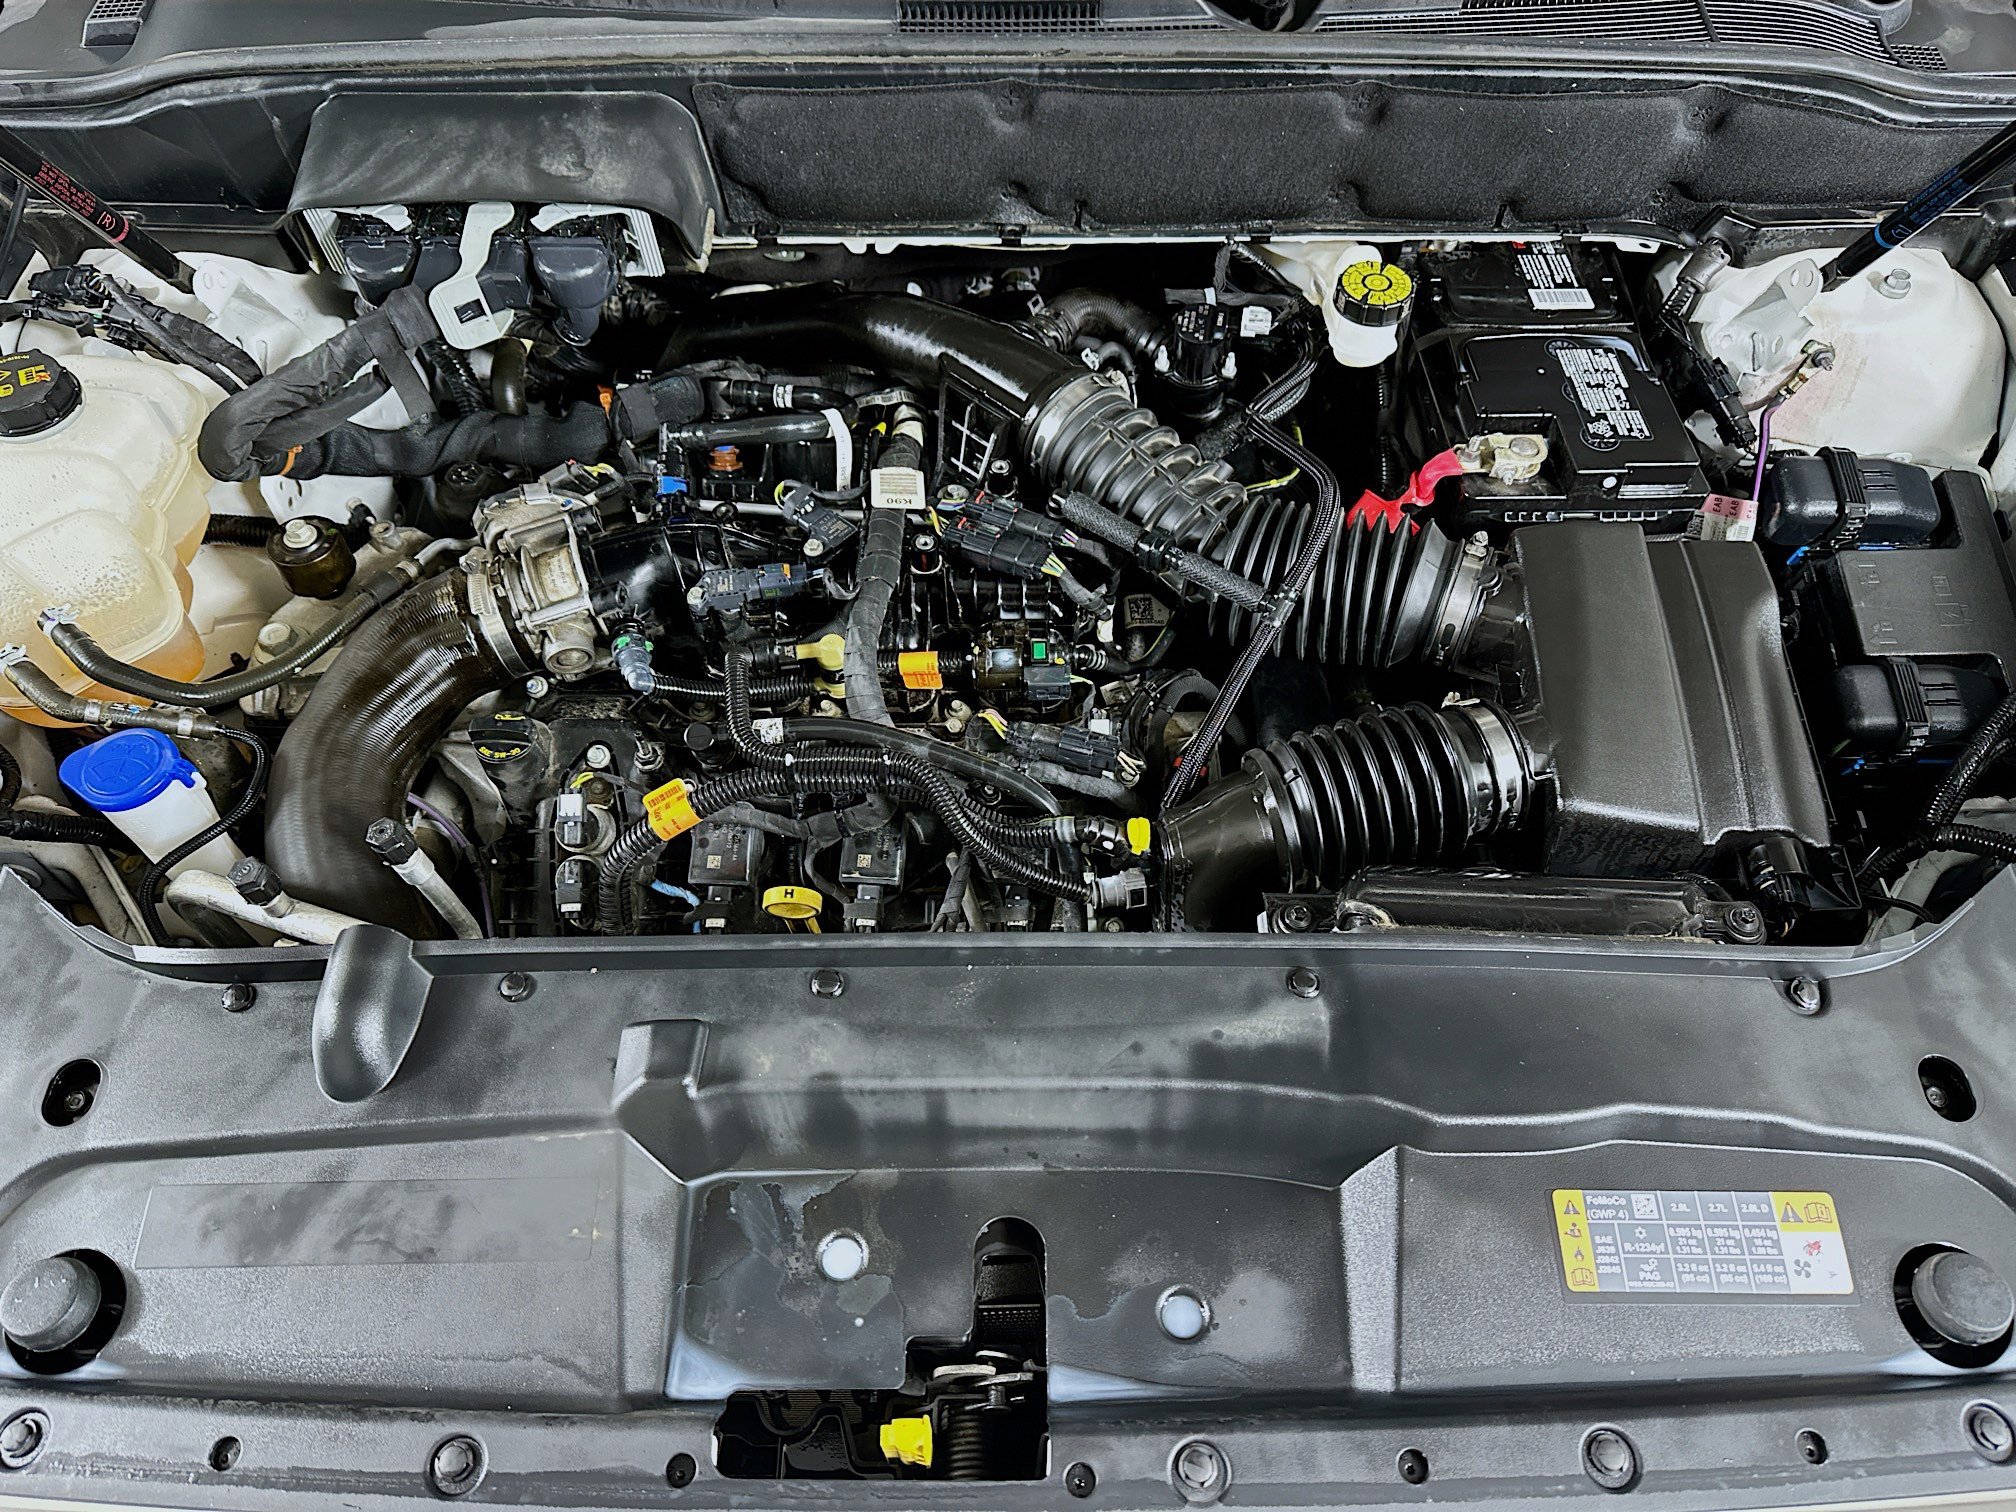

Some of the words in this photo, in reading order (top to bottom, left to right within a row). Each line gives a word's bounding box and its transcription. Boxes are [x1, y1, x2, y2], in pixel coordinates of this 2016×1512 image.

[97, 211, 116, 231] (R)
[886, 497, 912, 505] K90
[1713, 497, 1723, 513] EAB
[1730, 500, 1739, 516] EAB
[479, 746, 493, 757] SAE
[494, 748, 521, 758] 5W-30
[784, 889, 794, 898] H
[1586, 1195, 1627, 1206] FoMoCo
[1707, 1203, 1728, 1213] 2.7L
[1587, 1209, 1616, 1220] (GWP
[1617, 1209, 1629, 1221] 4)
[1691, 1228, 1703, 1239] kg
[1729, 1228, 1740, 1239] kg
[1767, 1228, 1778, 1239] kg
[1594, 1235, 1614, 1244] SAE
[1624, 1242, 1665, 1253] R-1234yf
[1639, 1271, 1661, 1281] PAG
